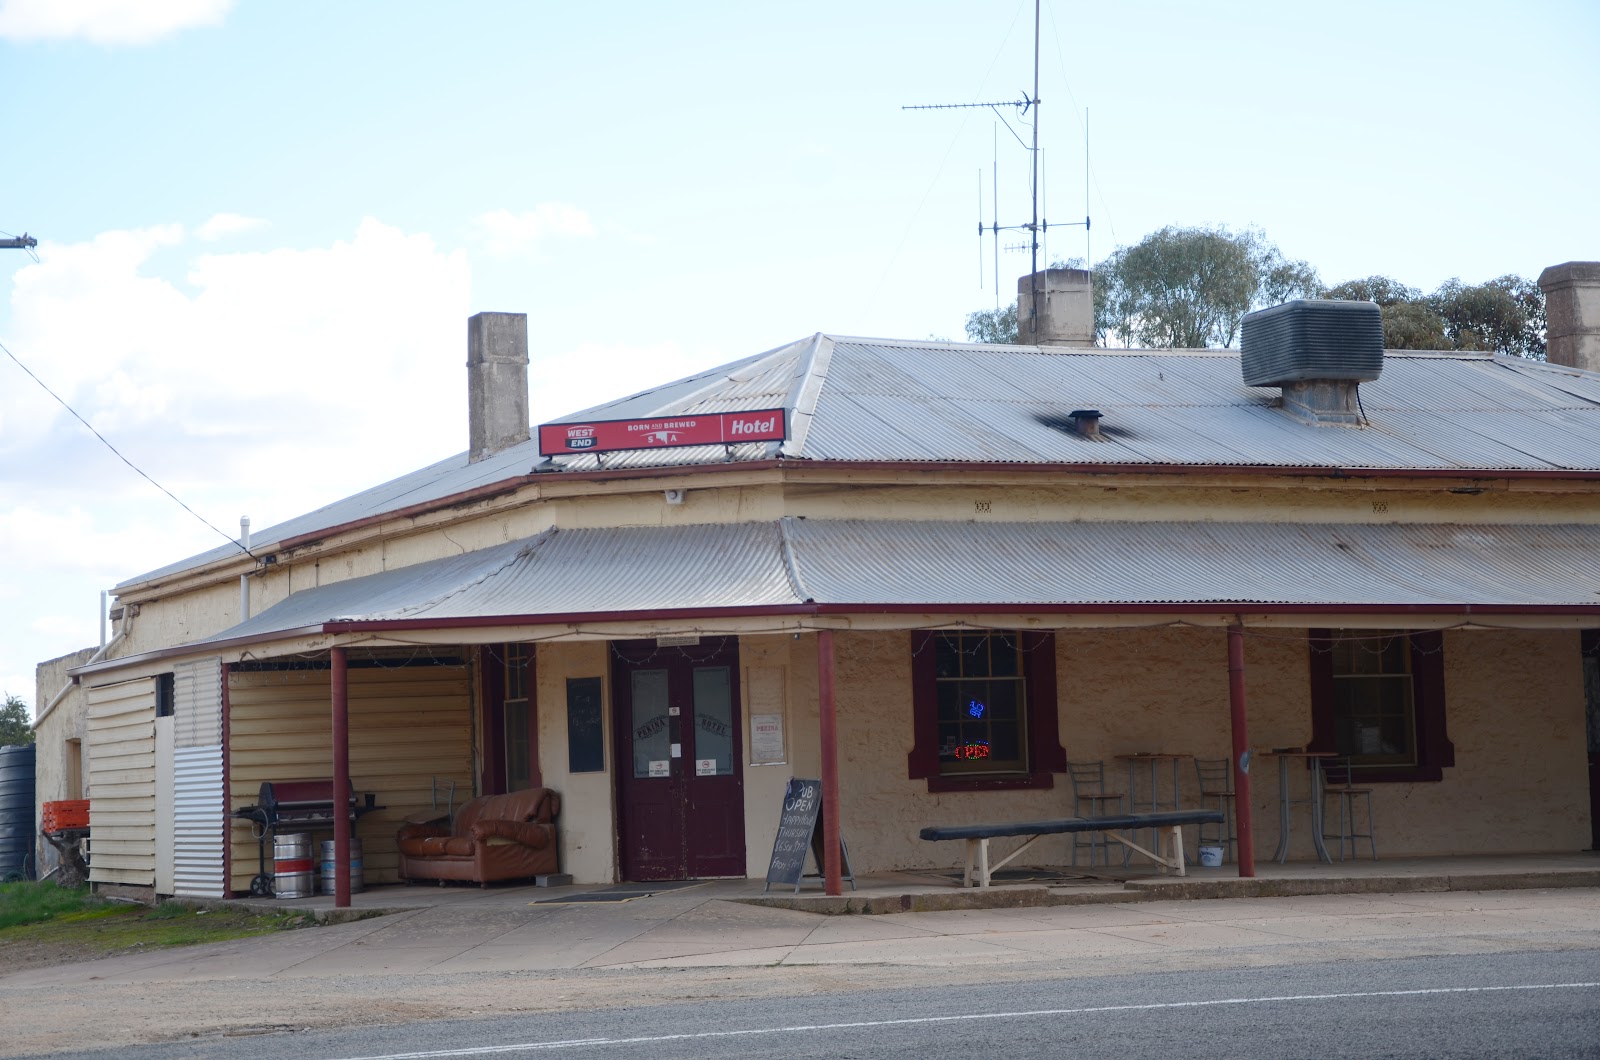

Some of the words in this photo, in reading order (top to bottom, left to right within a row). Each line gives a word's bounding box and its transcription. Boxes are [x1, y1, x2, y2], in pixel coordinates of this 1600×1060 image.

[627, 424, 650, 432] BORN
[664, 421, 696, 429] BREWED
[731, 417, 775, 435] Hotel
[567, 428, 594, 437] WEST
[570, 438, 592, 447] END
[647, 435, 653, 443] S
[670, 434, 677, 442] A
[637, 719, 665, 738] PEKINA
[701, 718, 726, 734] HOTEL
[786, 797, 813, 812] OPEN
